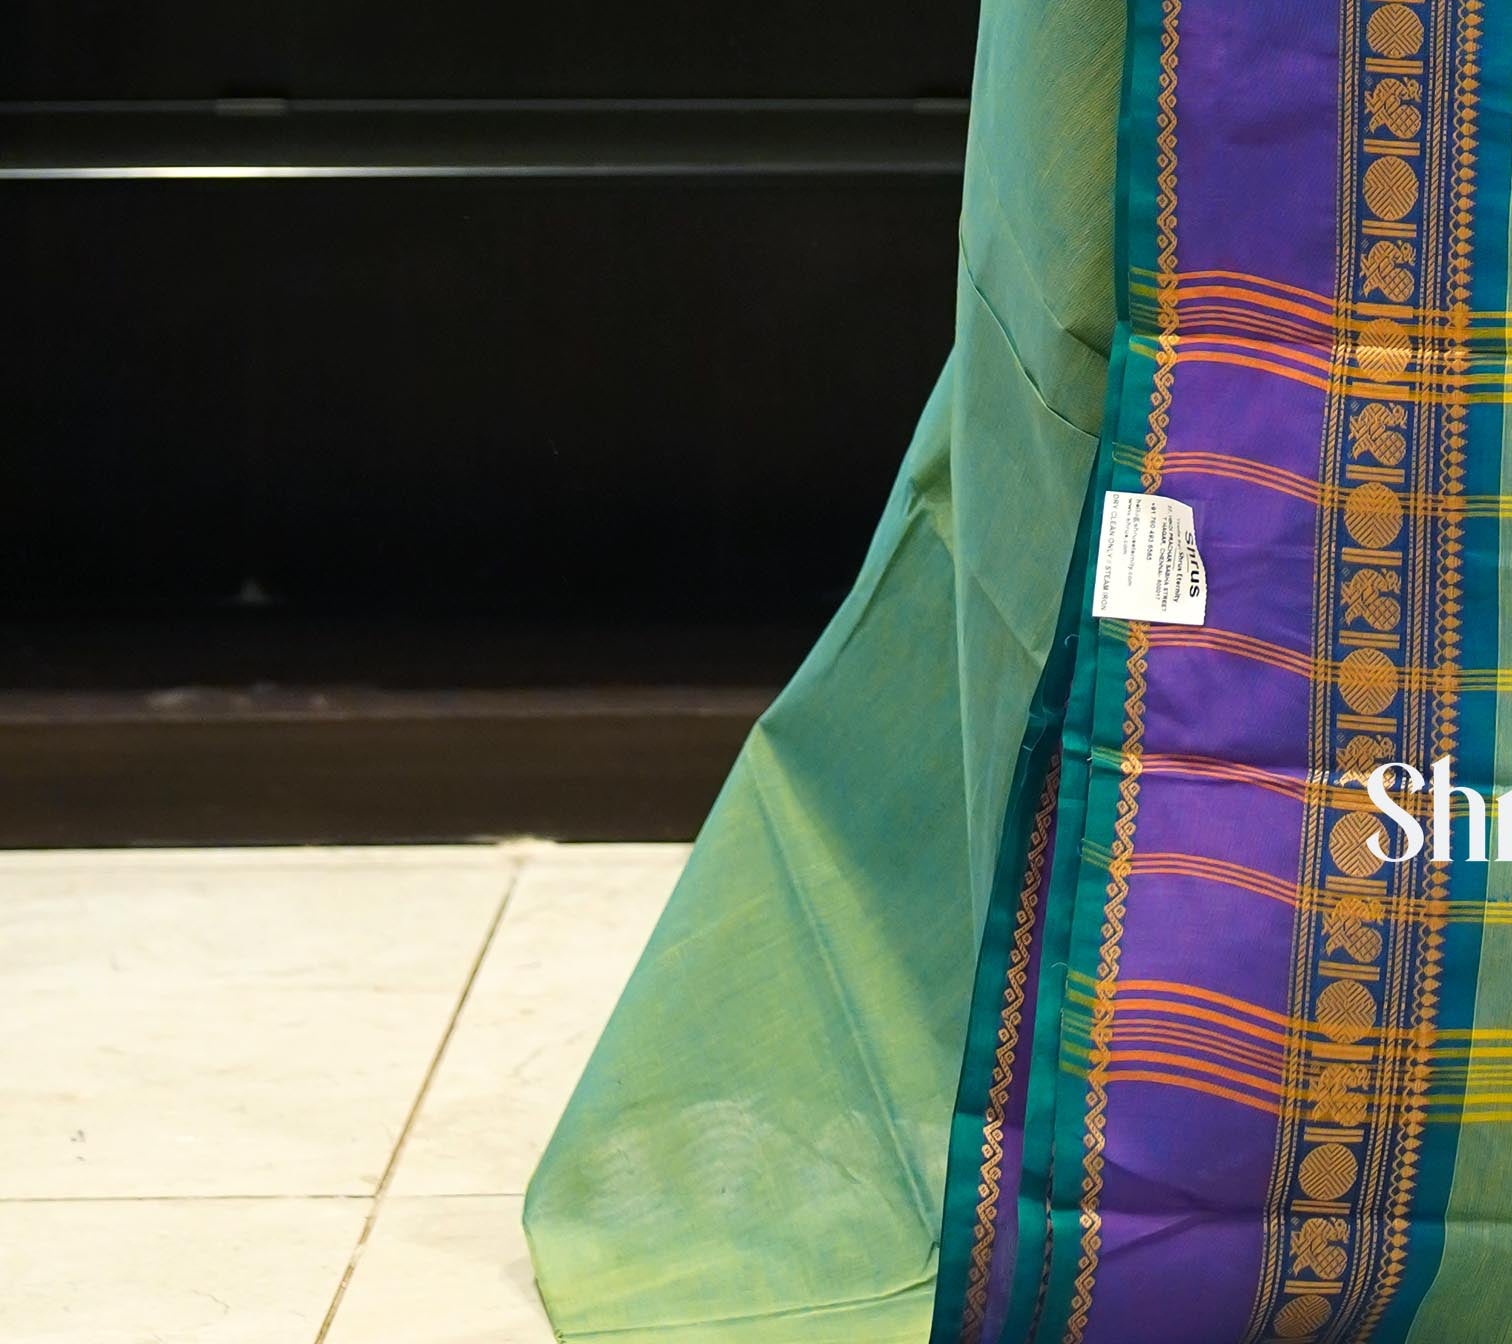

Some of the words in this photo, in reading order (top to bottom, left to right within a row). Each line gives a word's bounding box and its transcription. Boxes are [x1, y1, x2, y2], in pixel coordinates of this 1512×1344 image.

[1109, 511, 1117, 536] CLEAN
[1103, 565, 1112, 590] STEAM
[1173, 573, 1182, 602] Eternity
